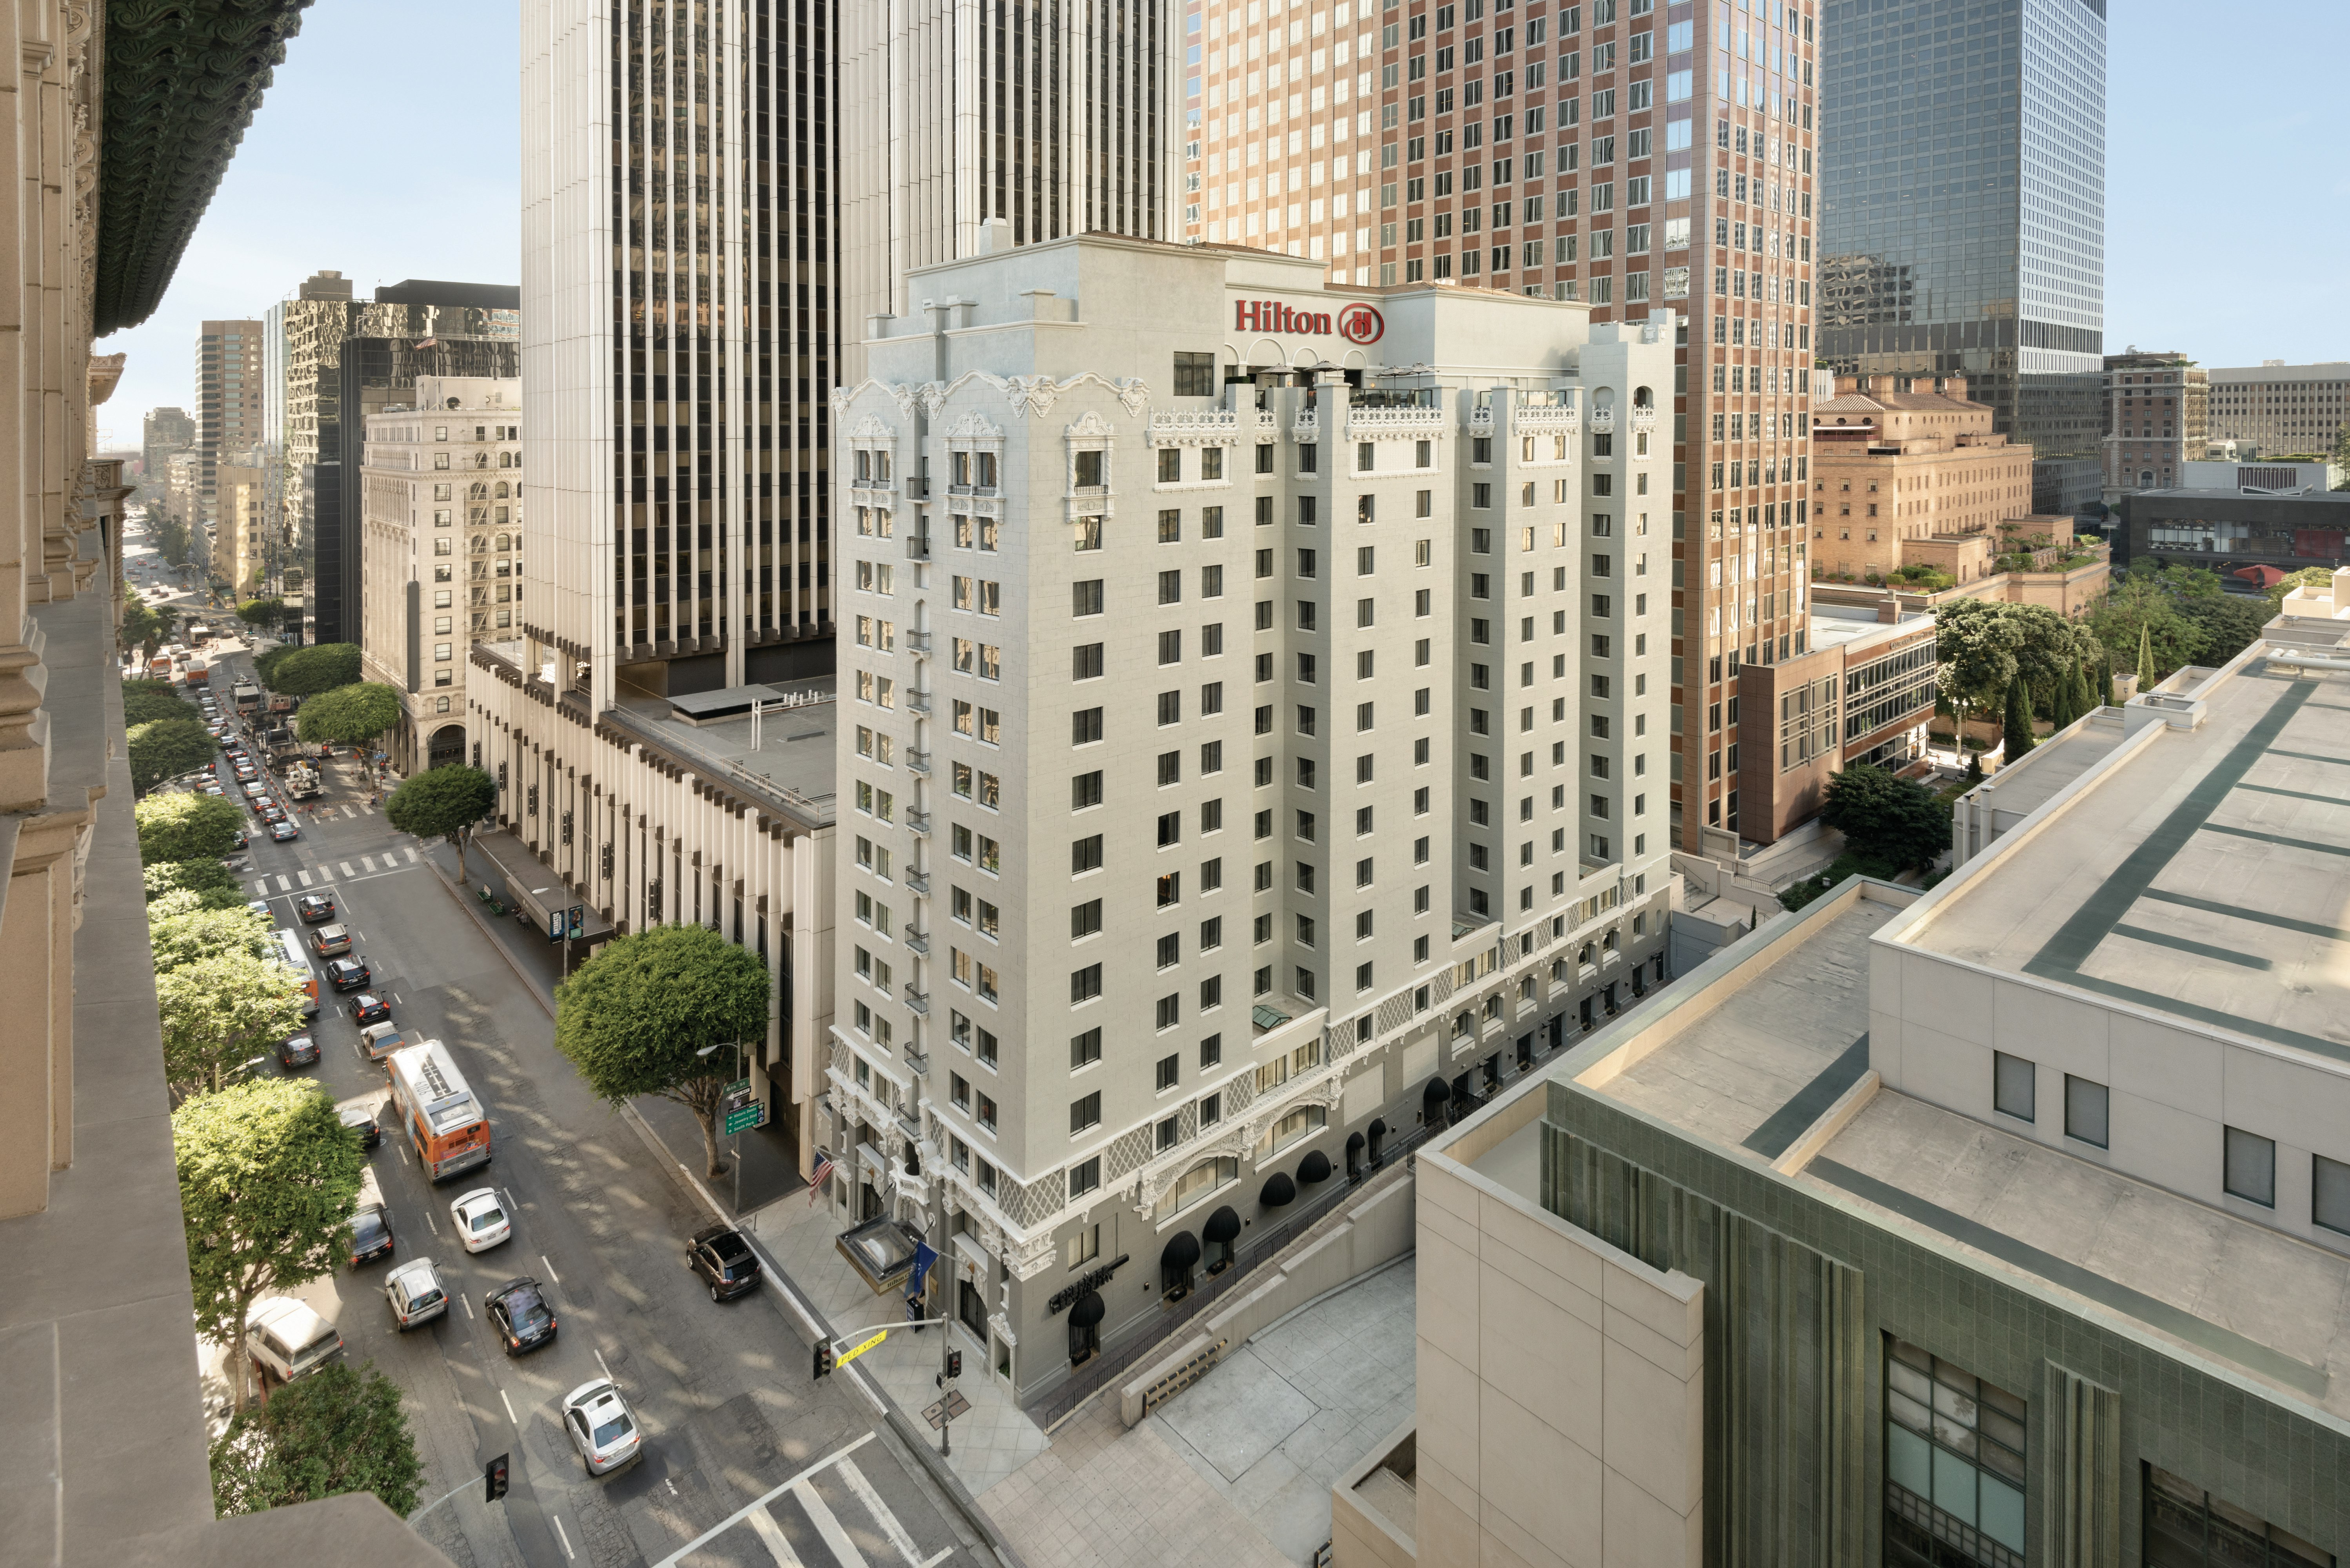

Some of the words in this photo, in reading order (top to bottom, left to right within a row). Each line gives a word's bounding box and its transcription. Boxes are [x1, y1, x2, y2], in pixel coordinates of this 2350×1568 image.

[1236, 300, 1332, 334] Hilton
[887, 1276, 904, 1287] Hilton
[841, 1349, 859, 1363] PED
[862, 1334, 882, 1351] XING
